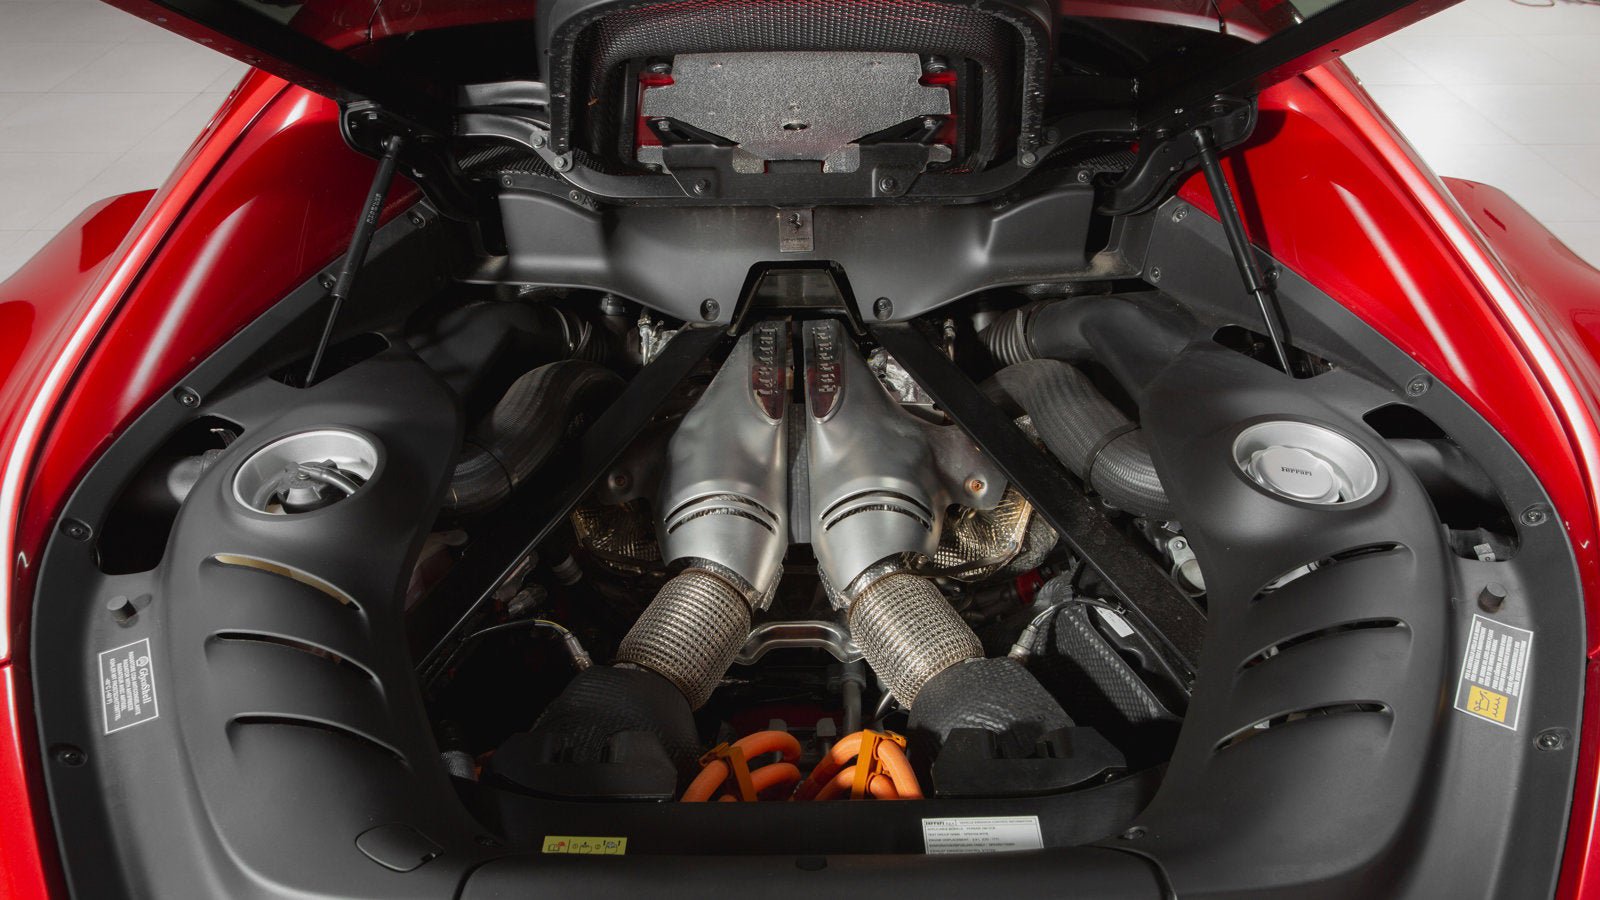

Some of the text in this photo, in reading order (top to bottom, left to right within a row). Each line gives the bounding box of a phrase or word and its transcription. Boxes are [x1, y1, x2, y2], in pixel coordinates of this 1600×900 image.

[759, 327, 778, 395] Ferrari
[812, 325, 836, 393] Ferrari
[1280, 466, 1312, 476] Ferrari
[138, 668, 151, 704] GlycoShell
